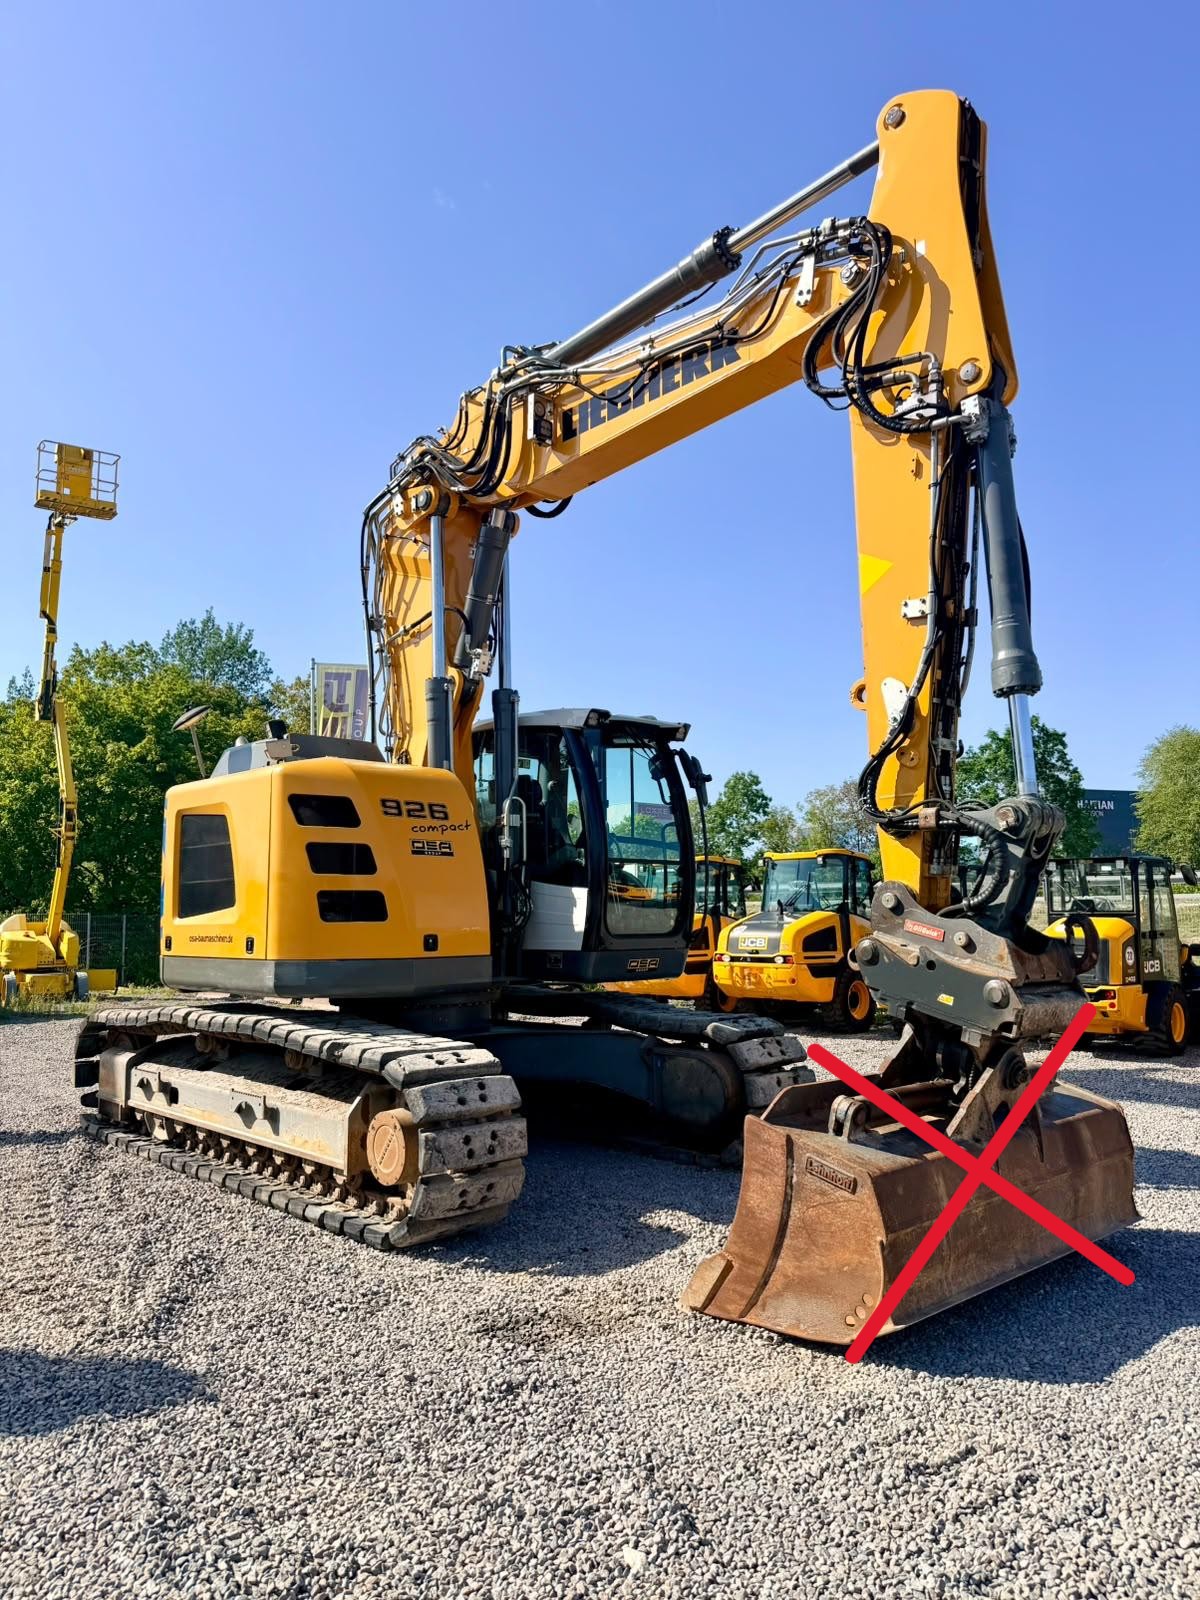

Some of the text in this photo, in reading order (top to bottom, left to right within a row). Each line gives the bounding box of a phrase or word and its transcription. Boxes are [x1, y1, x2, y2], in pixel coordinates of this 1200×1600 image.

[562, 339, 741, 441] LIEBHERR
[380, 798, 449, 820] 926
[411, 819, 471, 835] compact
[740, 936, 766, 948] JCB
[1144, 960, 1161, 973] JCB
